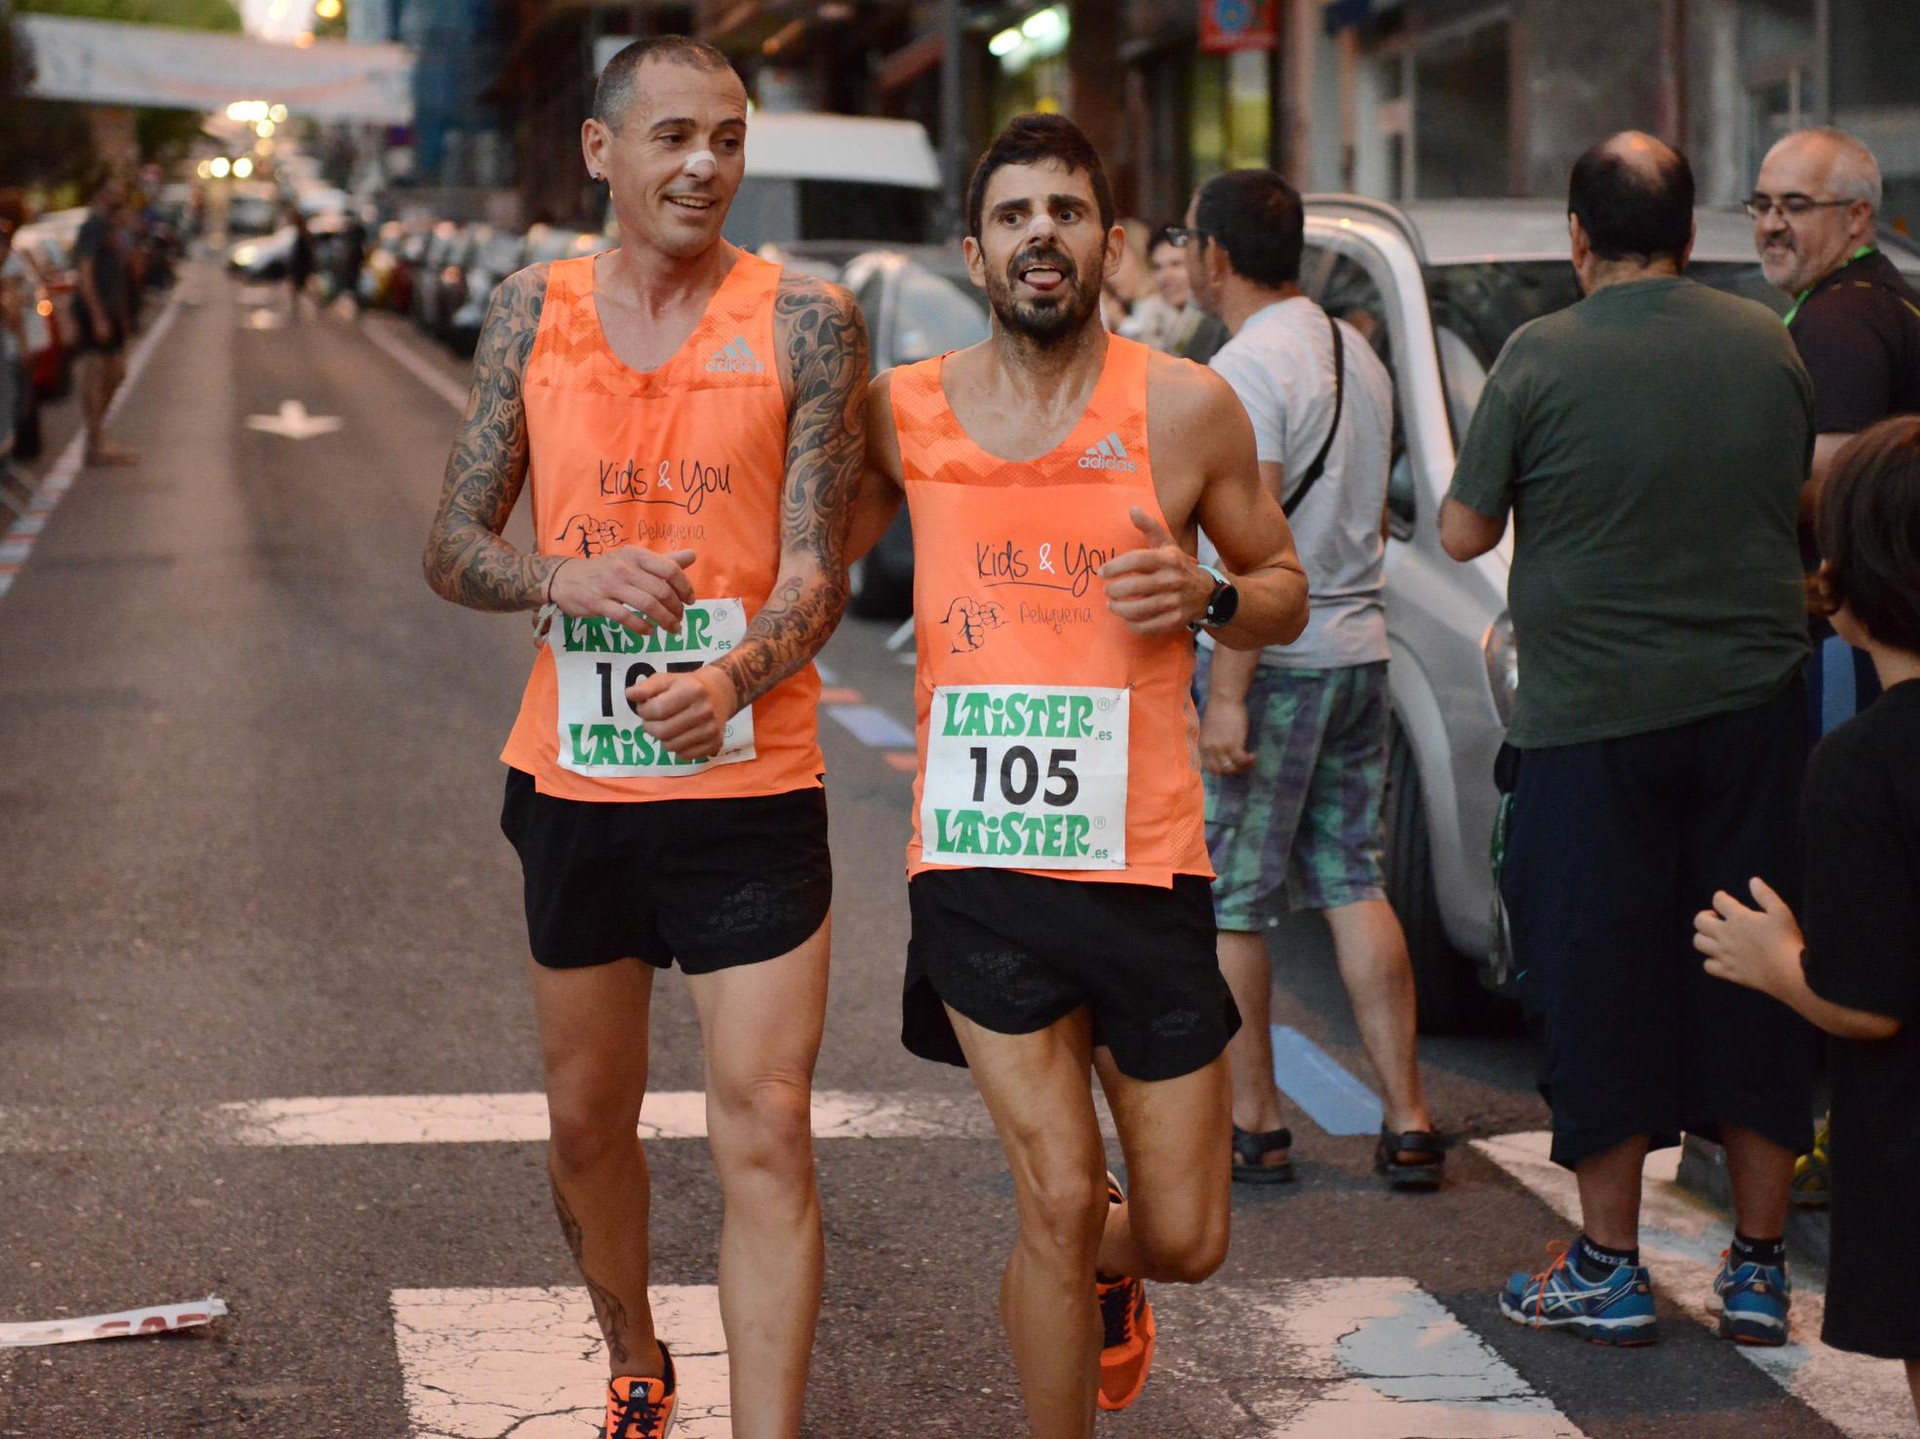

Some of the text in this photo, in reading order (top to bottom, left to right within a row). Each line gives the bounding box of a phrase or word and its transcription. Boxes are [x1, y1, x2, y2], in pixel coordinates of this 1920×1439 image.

[704, 357, 765, 373] adidas
[1077, 455, 1137, 473] adidas
[599, 458, 731, 515] Kids & You
[976, 540, 1030, 580] Kids
[1038, 542, 1056, 575] &
[595, 660, 705, 718] 10
[568, 723, 711, 767] LAiS
[1094, 728, 1112, 741] .es
[969, 744, 1079, 807] 105
[1091, 847, 1109, 860] .es
